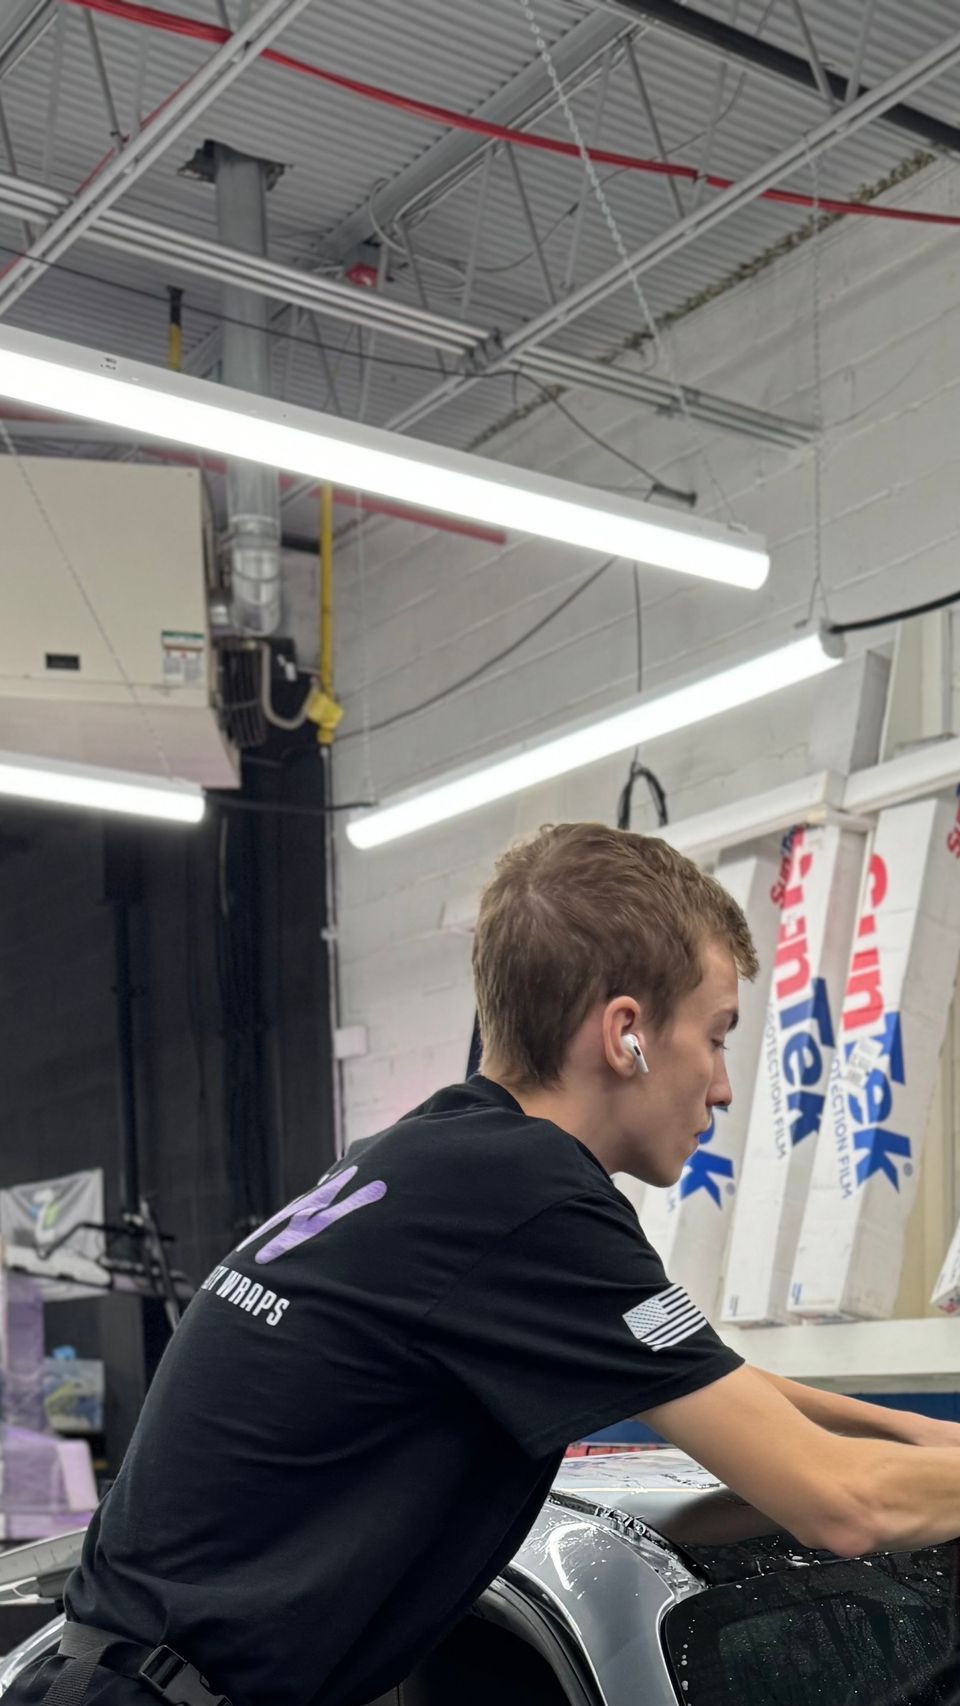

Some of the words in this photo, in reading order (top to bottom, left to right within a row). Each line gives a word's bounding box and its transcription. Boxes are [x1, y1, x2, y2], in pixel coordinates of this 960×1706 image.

[829, 1050, 848, 1151] OTECTION
[773, 1118, 787, 1160] FILM
[838, 1155, 853, 1199] FILM
[216, 1270, 290, 1327] WRAPS
